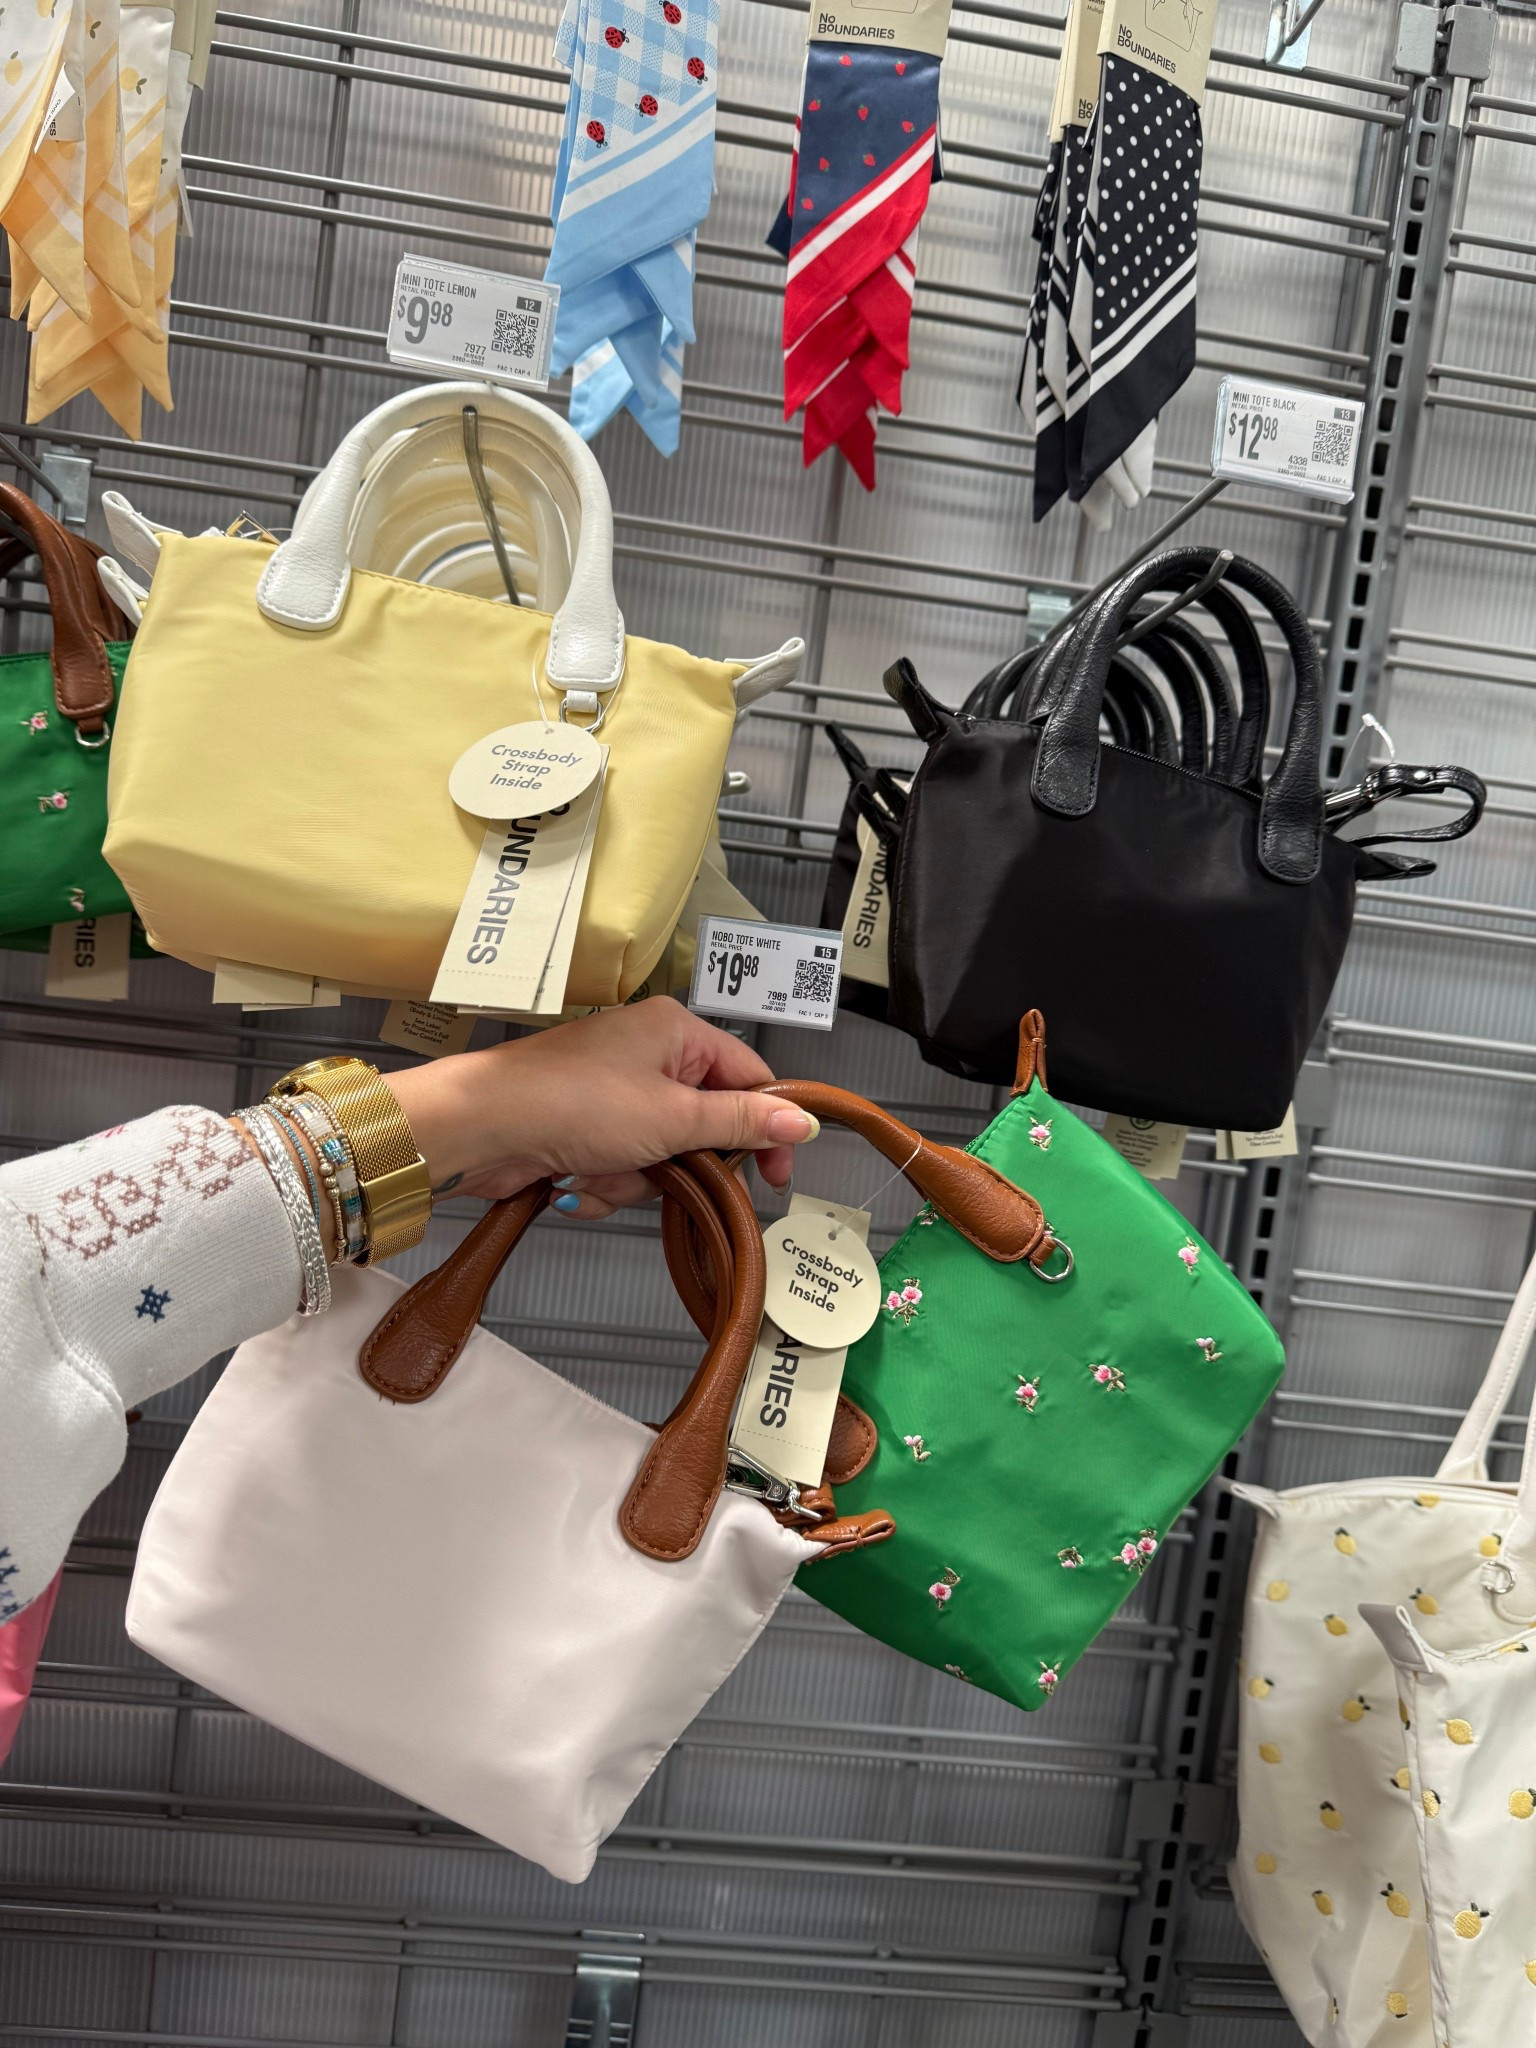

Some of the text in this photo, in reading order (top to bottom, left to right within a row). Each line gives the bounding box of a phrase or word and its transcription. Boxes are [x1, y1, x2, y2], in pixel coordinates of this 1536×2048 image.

[820, 13, 836, 24] No
[1119, 24, 1132, 38] No
[1080, 98, 1093, 110] No
[400, 284, 436, 298] RETAIL PRICE
[402, 273, 477, 298] MINI TOTE LEMON
[524, 300, 534, 310] 12
[464, 342, 486, 356] 7977
[496, 364, 508, 372] FAC
[1232, 392, 1296, 412] MINI TOTE BLACK
[1232, 402, 1248, 411] RETAIL
[1340, 410, 1350, 420] 13
[1288, 455, 1308, 466] 4338
[490, 744, 583, 768] Crossbody
[502, 759, 550, 776] Strap
[490, 774, 542, 790] Inside
[467, 816, 542, 965] UNDARIES
[712, 931, 781, 950] NOBO TOTE WHITE
[821, 948, 832, 958] 15
[768, 991, 788, 1002] 7989
[426, 1021, 442, 1030] Label
[404, 1028, 442, 1044] Fiber Content
[782, 1238, 864, 1288] Crossbody
[795, 1263, 839, 1294] Strap
[788, 1280, 836, 1312] Inside
